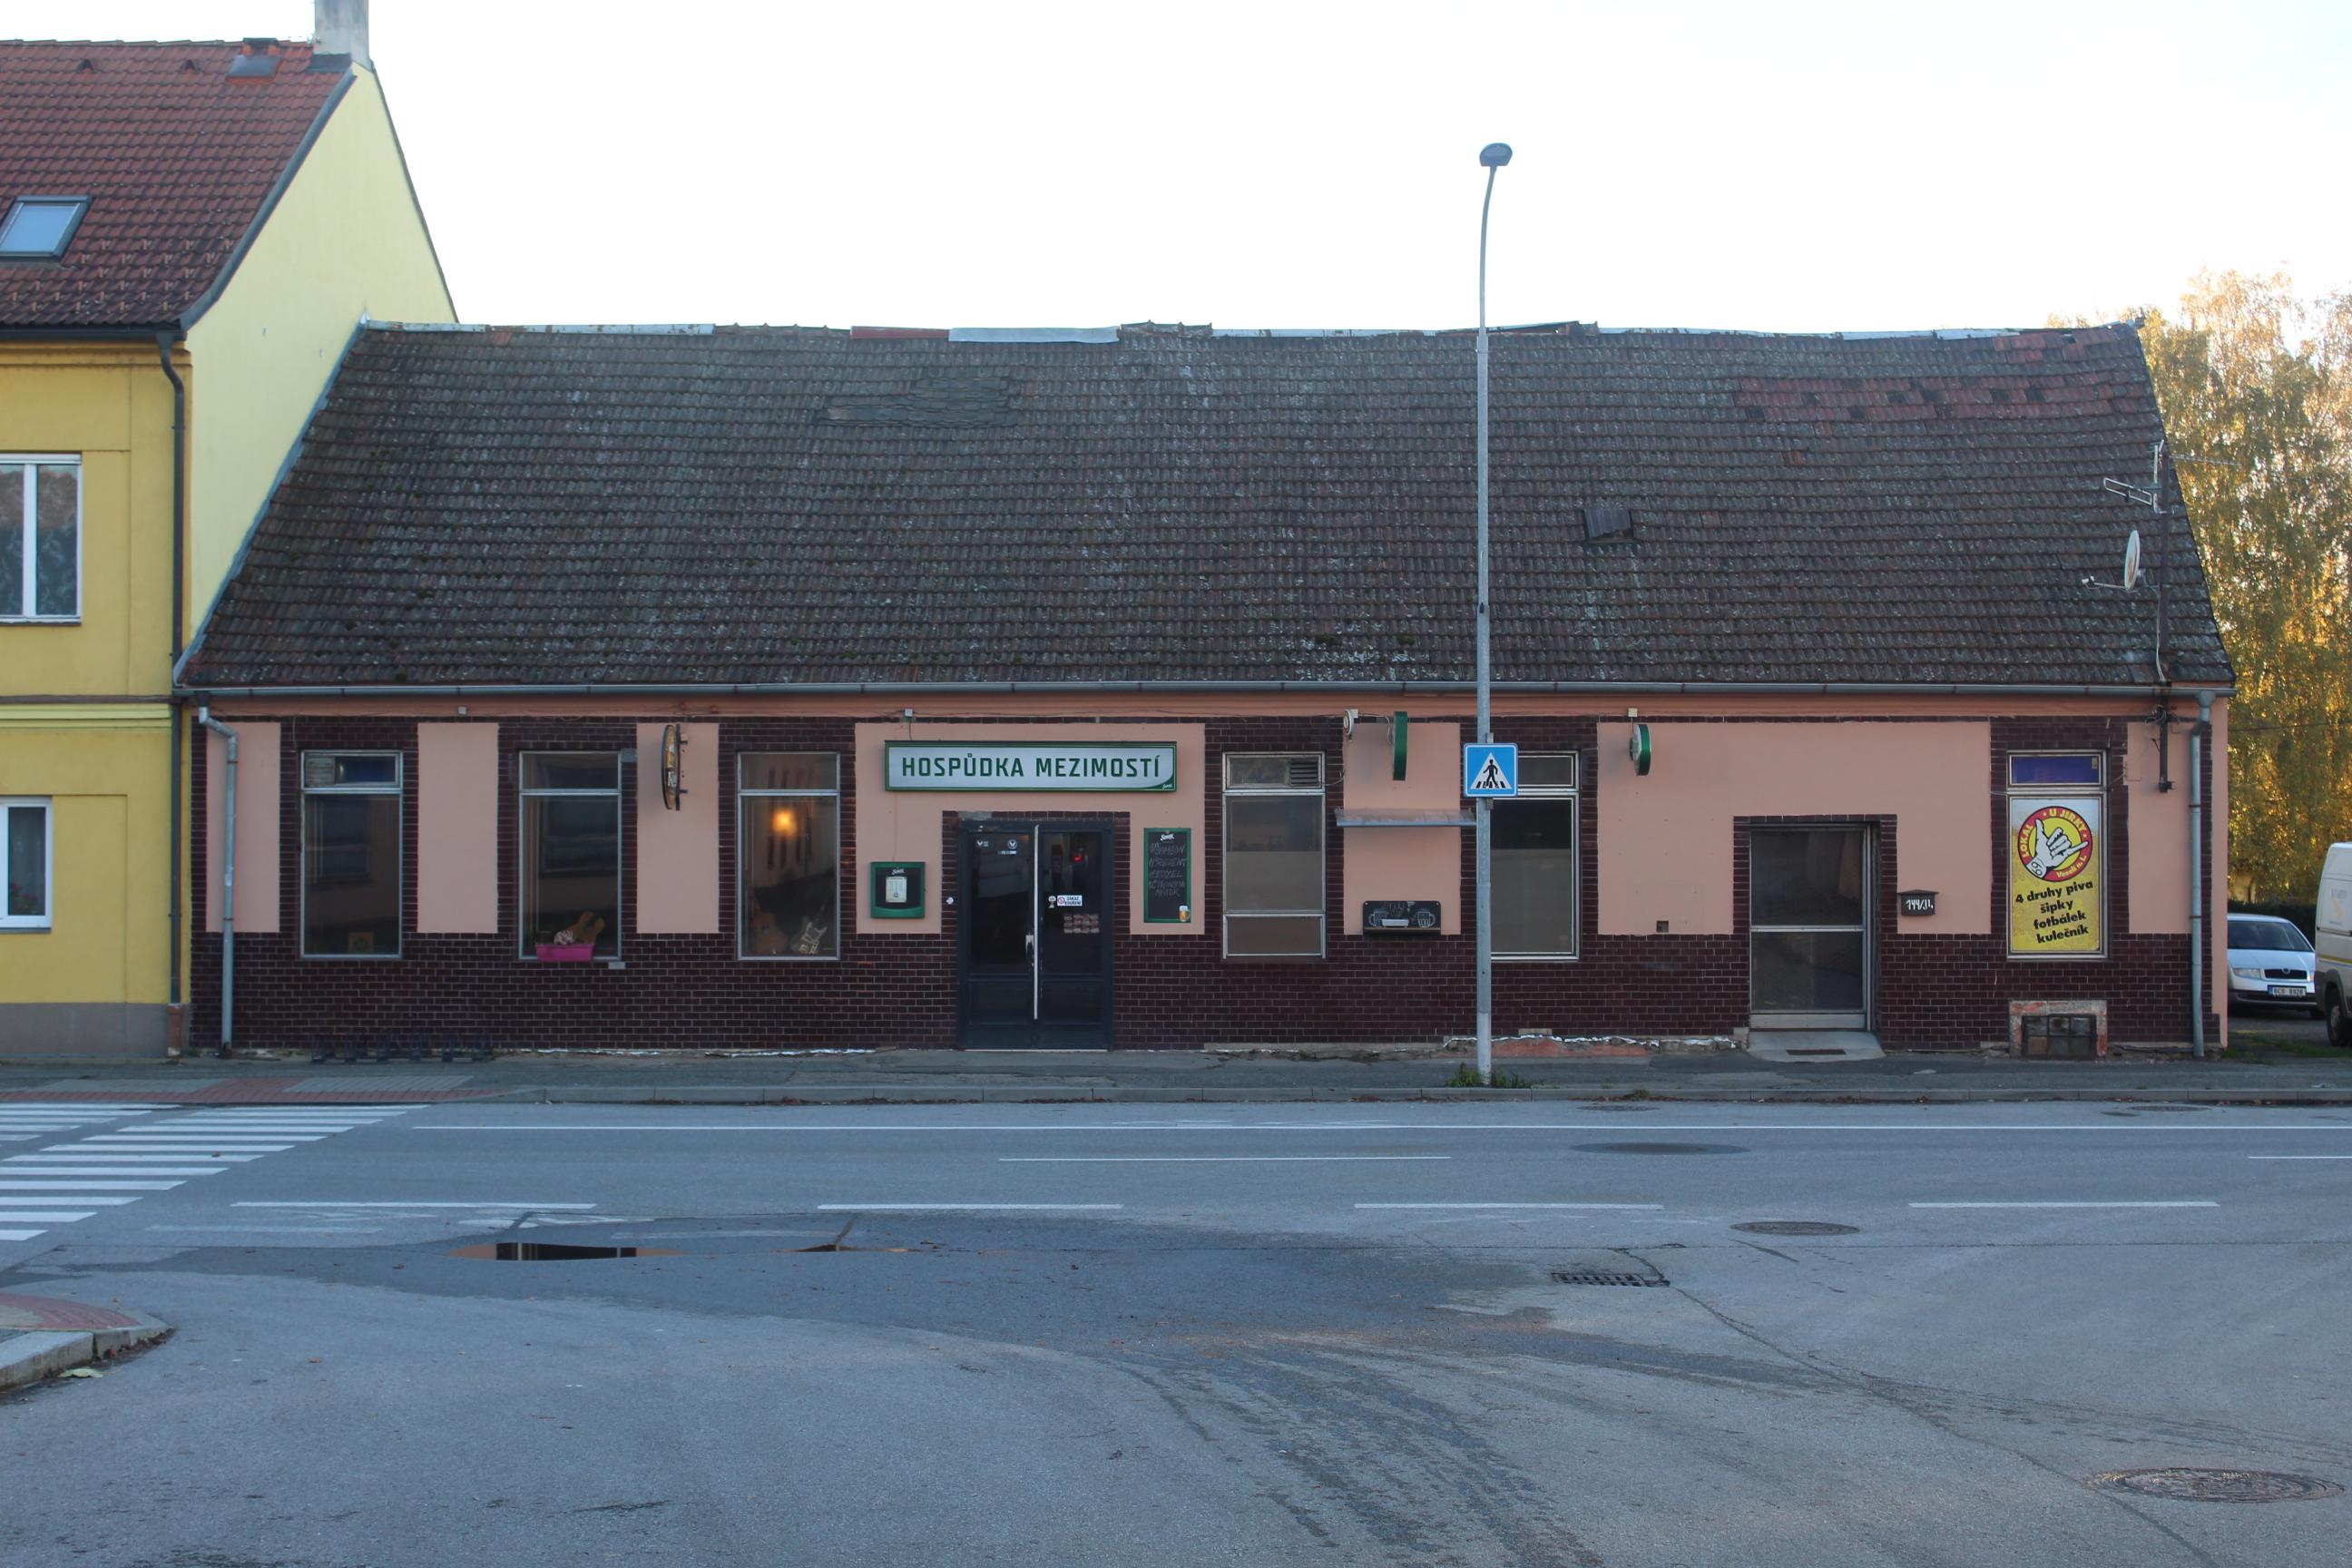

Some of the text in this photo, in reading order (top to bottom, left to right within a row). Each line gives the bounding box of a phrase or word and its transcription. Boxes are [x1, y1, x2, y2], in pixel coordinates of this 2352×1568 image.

[902, 753, 1161, 778] HOSPŮDKA MEZIMOSTÍ
[2049, 808, 2057, 817] U
[2060, 809, 2087, 832] JIRKY
[2015, 881, 2093, 904] 4 druhy piva
[2040, 900, 2073, 914] šipky
[2034, 910, 2086, 929] fotbálek
[2036, 924, 2089, 944] kulečník
